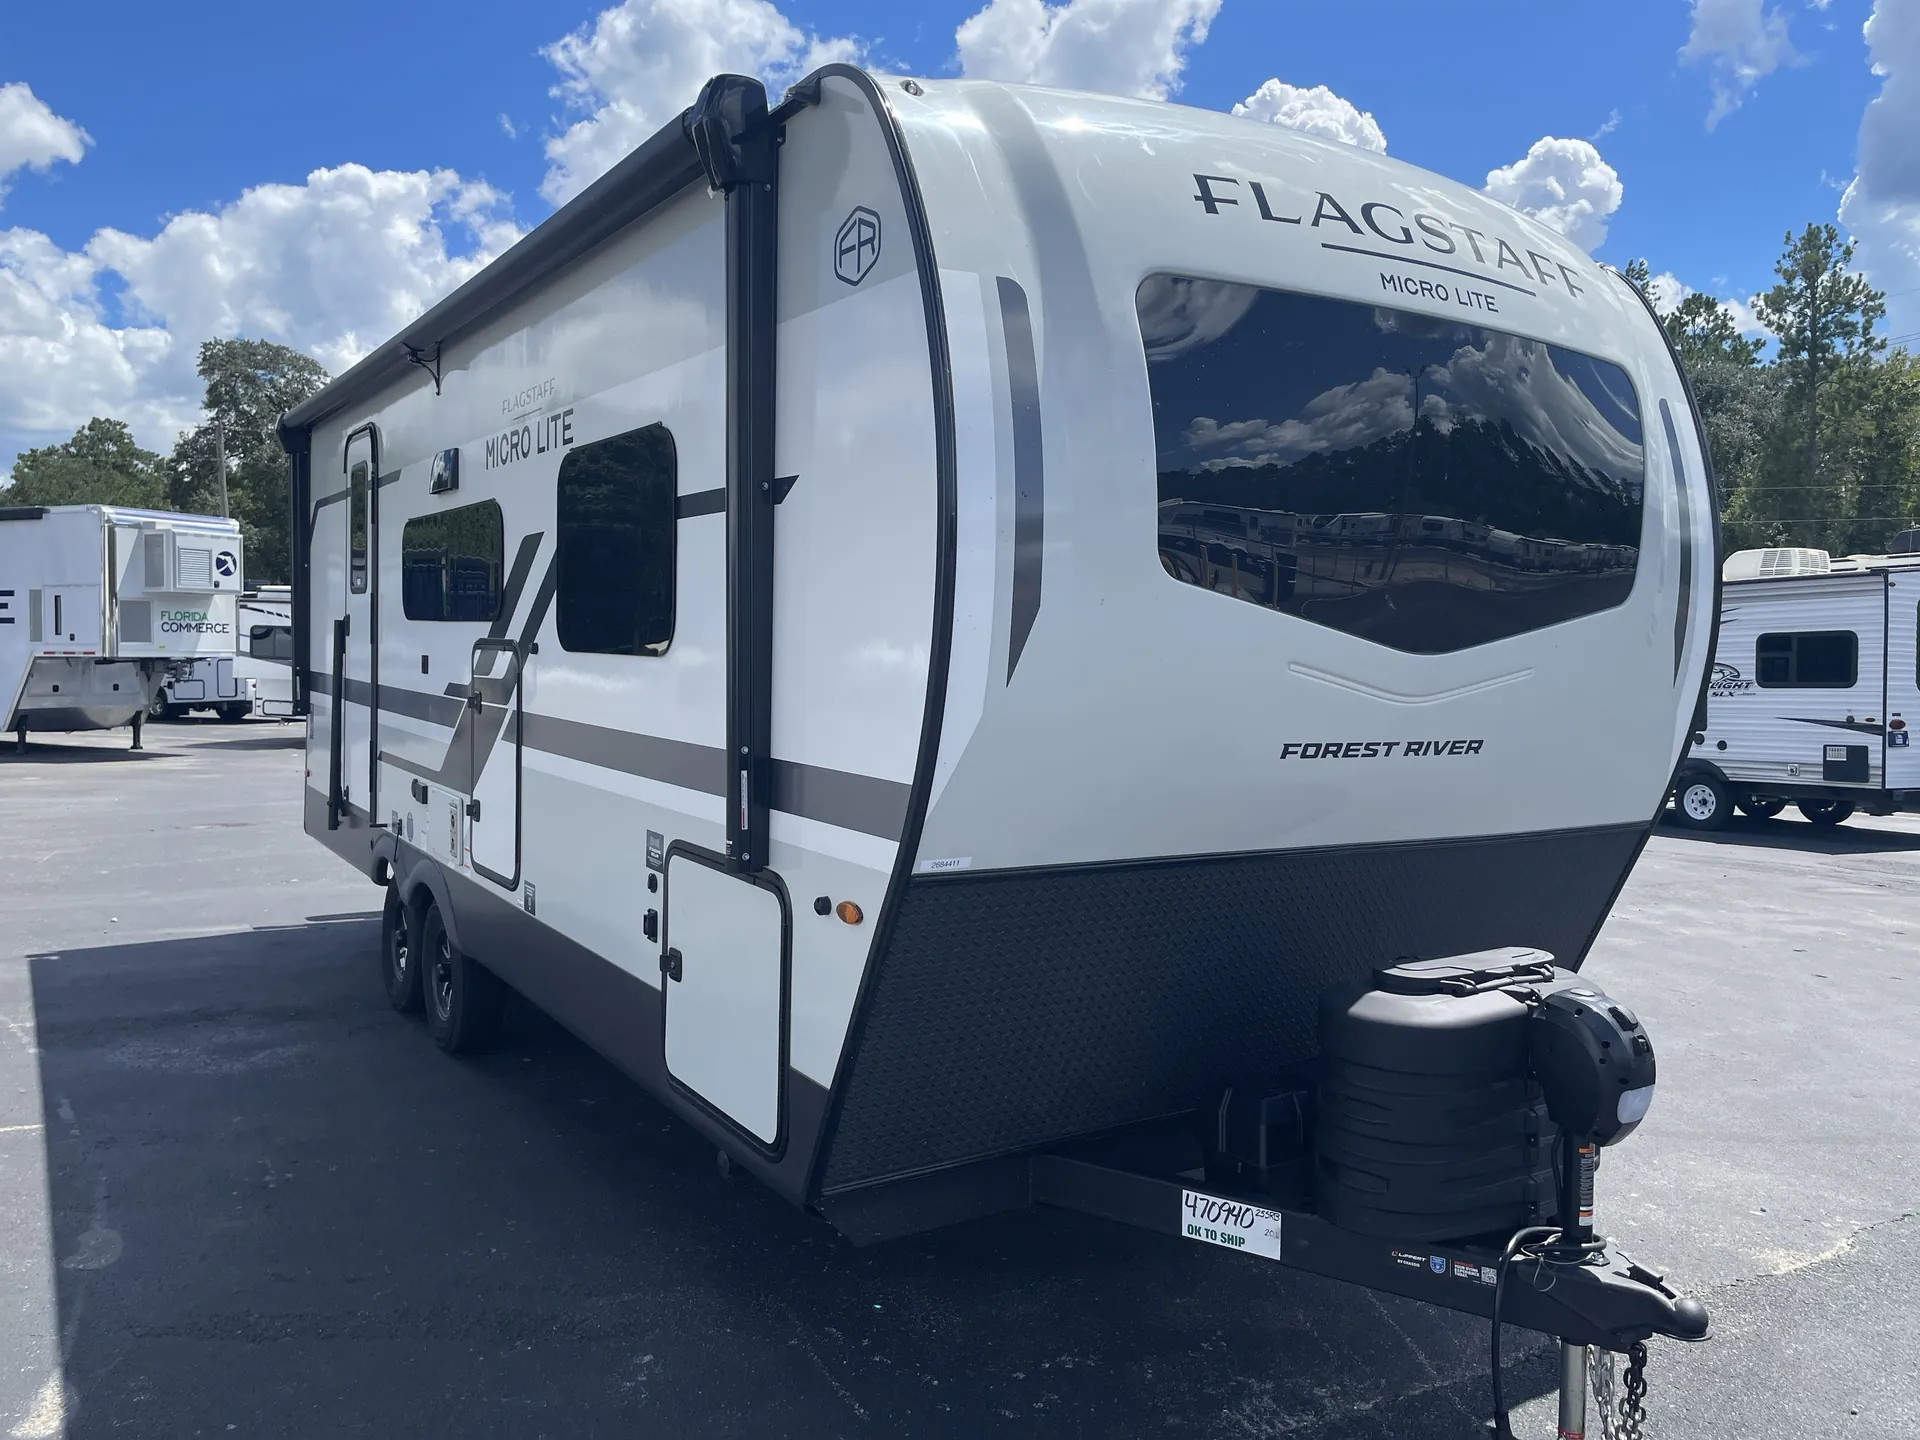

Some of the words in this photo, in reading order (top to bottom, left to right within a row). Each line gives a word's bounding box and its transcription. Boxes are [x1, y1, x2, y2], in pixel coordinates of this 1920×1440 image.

[1192, 173, 1585, 298] FLAGSTAFF
[1380, 272, 1450, 302] MICRO
[1458, 288, 1498, 313] LITE
[502, 377, 555, 415] FLAGSTAFF
[485, 425, 531, 470] MICRO
[537, 408, 573, 454] LITE
[160, 610, 208, 622] FLORIDA
[161, 621, 229, 633] COMMERCE
[1709, 681, 1753, 689] LIGHT
[1280, 741, 1400, 760] FOREST
[1403, 739, 1484, 757] RIVER
[1184, 1192, 1255, 1229] 470940
[1187, 1223, 1201, 1237] OK
[1204, 1227, 1217, 1241] TO
[1220, 1231, 1246, 1248] SHIP
[1398, 1252, 1427, 1262] LIPPERT
